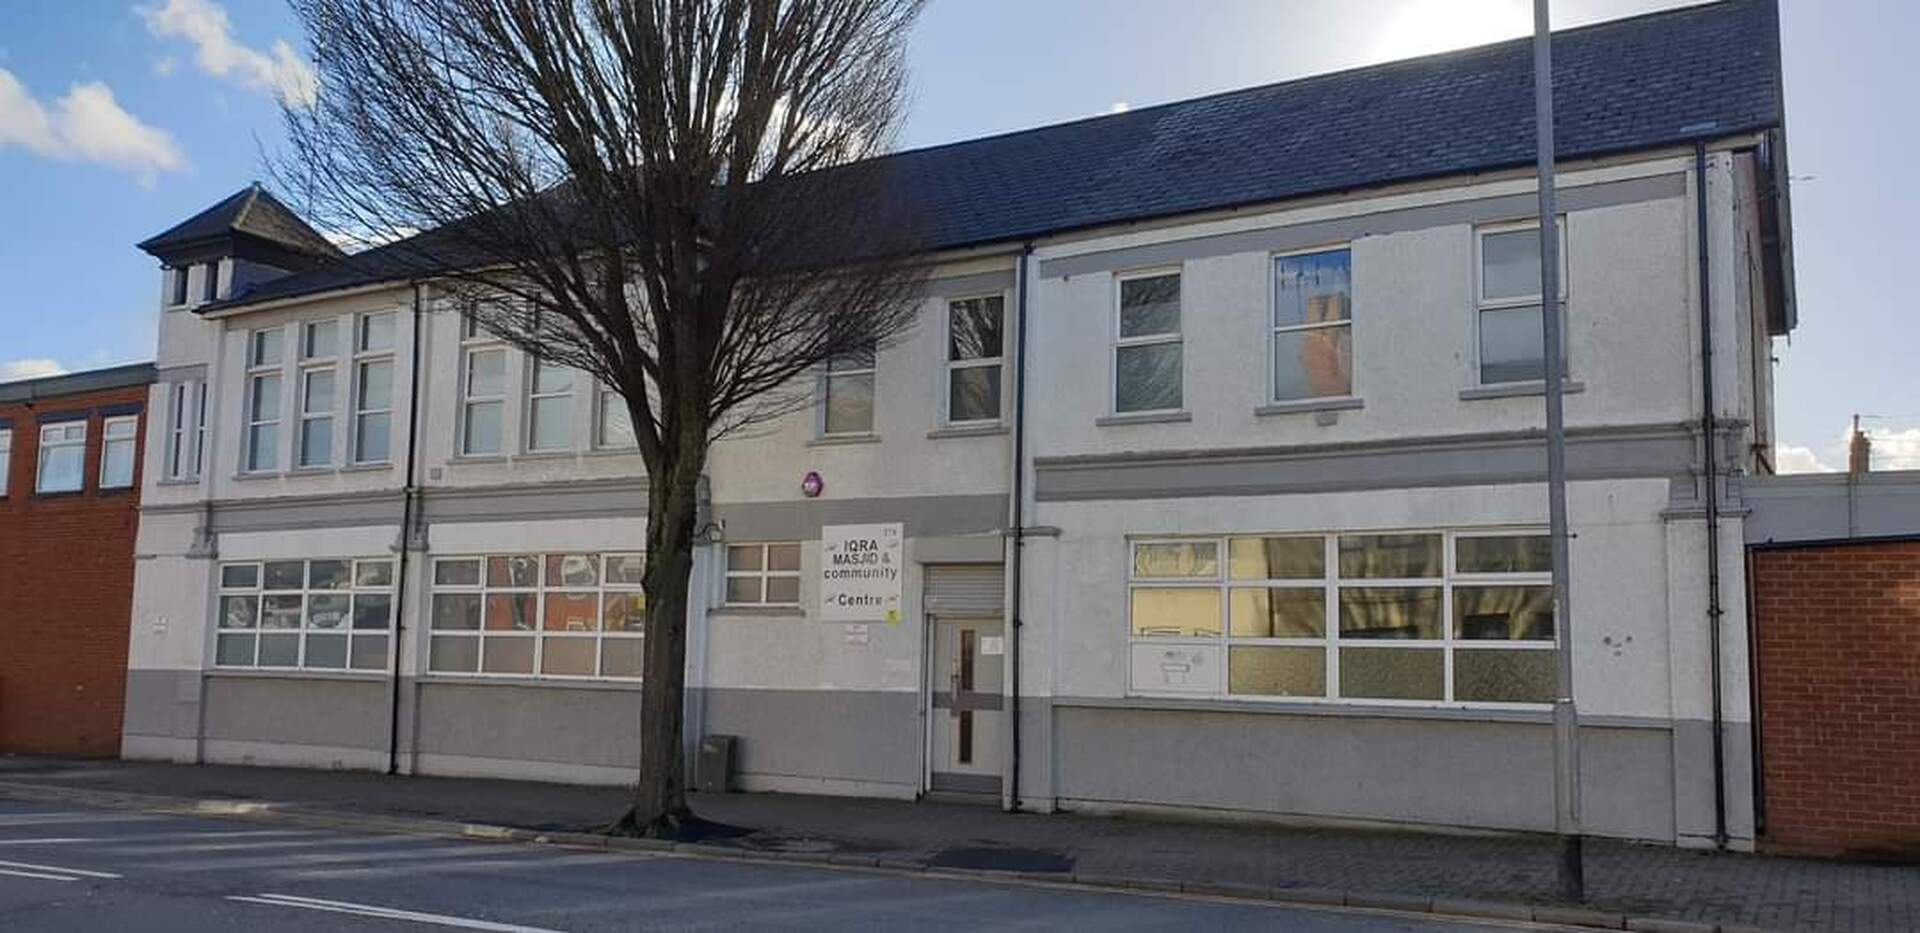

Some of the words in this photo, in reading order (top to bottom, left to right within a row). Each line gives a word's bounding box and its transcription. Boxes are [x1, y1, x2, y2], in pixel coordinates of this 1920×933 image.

[844, 539, 878, 552] IQRA
[833, 553, 878, 564] MASJID
[881, 552, 891, 564] &
[824, 567, 897, 581] community
